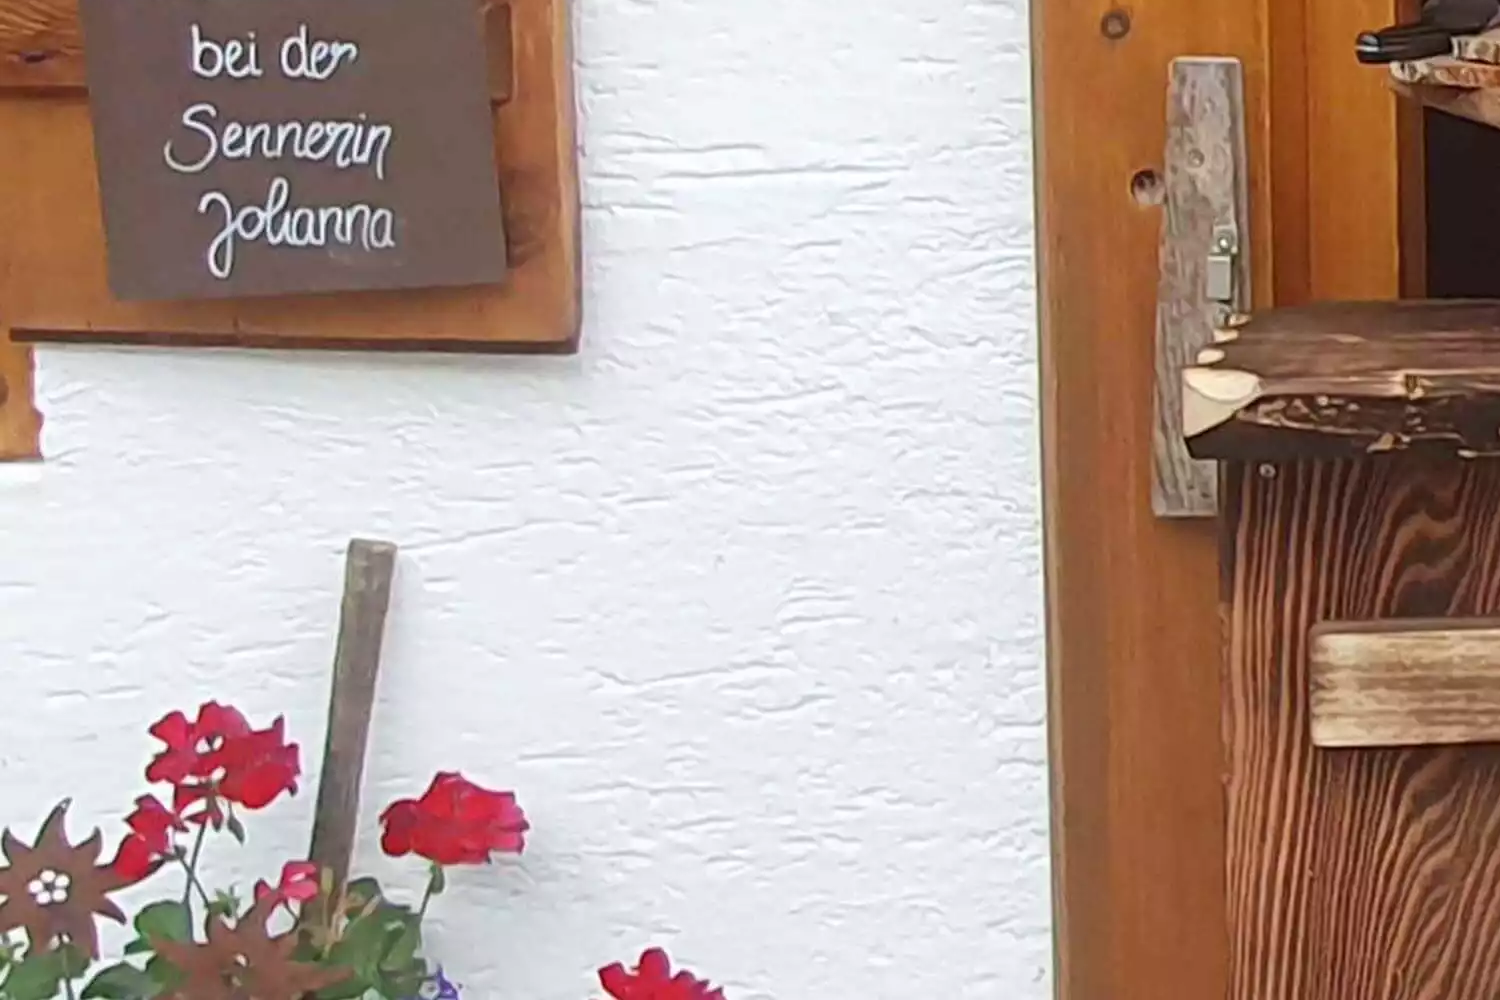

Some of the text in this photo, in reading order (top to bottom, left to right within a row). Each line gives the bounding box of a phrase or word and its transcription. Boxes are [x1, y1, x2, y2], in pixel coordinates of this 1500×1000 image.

[190, 23, 358, 80] bei der
[163, 103, 392, 180] Sennerin
[198, 176, 397, 280] Johanna
